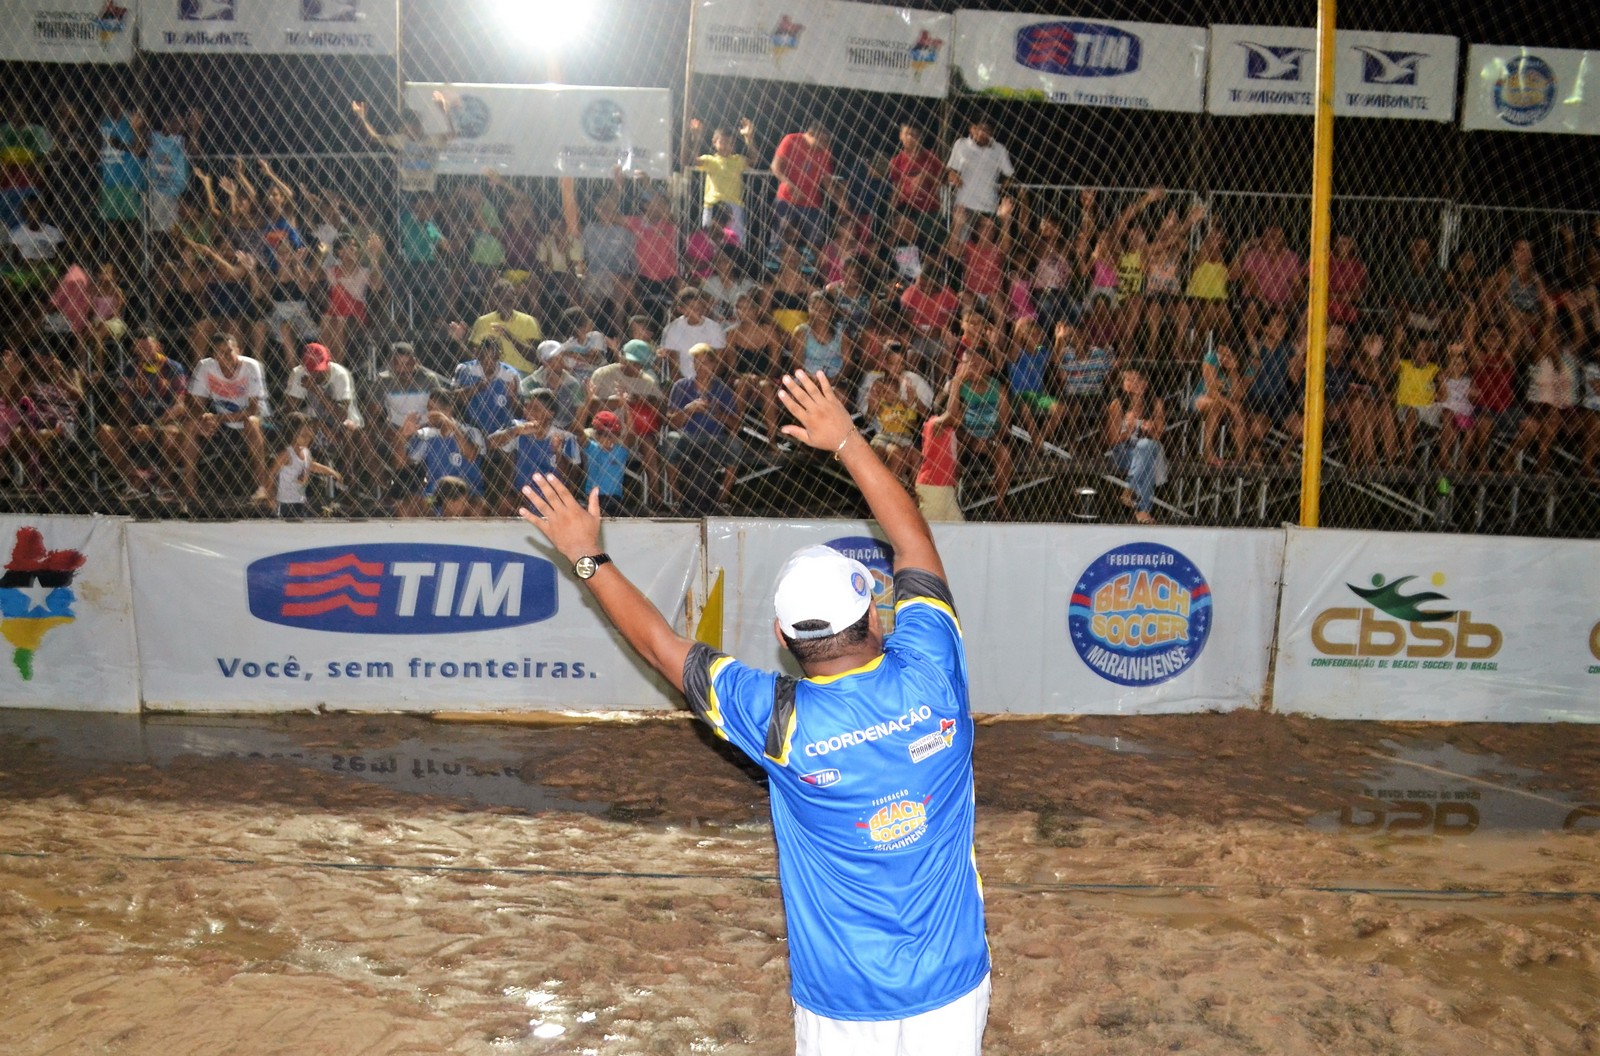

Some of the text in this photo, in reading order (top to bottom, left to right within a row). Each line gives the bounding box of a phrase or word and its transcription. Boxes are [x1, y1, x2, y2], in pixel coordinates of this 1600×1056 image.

[1073, 33, 1131, 70] TIM
[1107, 552, 1175, 568] FEDERAÇÃO
[390, 561, 526, 617] TIM
[1094, 570, 1191, 617] BEACH
[1091, 613, 1191, 648] SOCCER
[216, 655, 598, 682] Você, sem fronteiras.
[1085, 645, 1191, 681] MARANHENSE
[1311, 657, 1499, 672] CONFEDERAÇÃO DE BEACH SOCCER DO BRASIL
[804, 705, 932, 757] COORDENAÇÃO
[815, 771, 836, 785] TIM
[868, 800, 927, 832] BEACH
